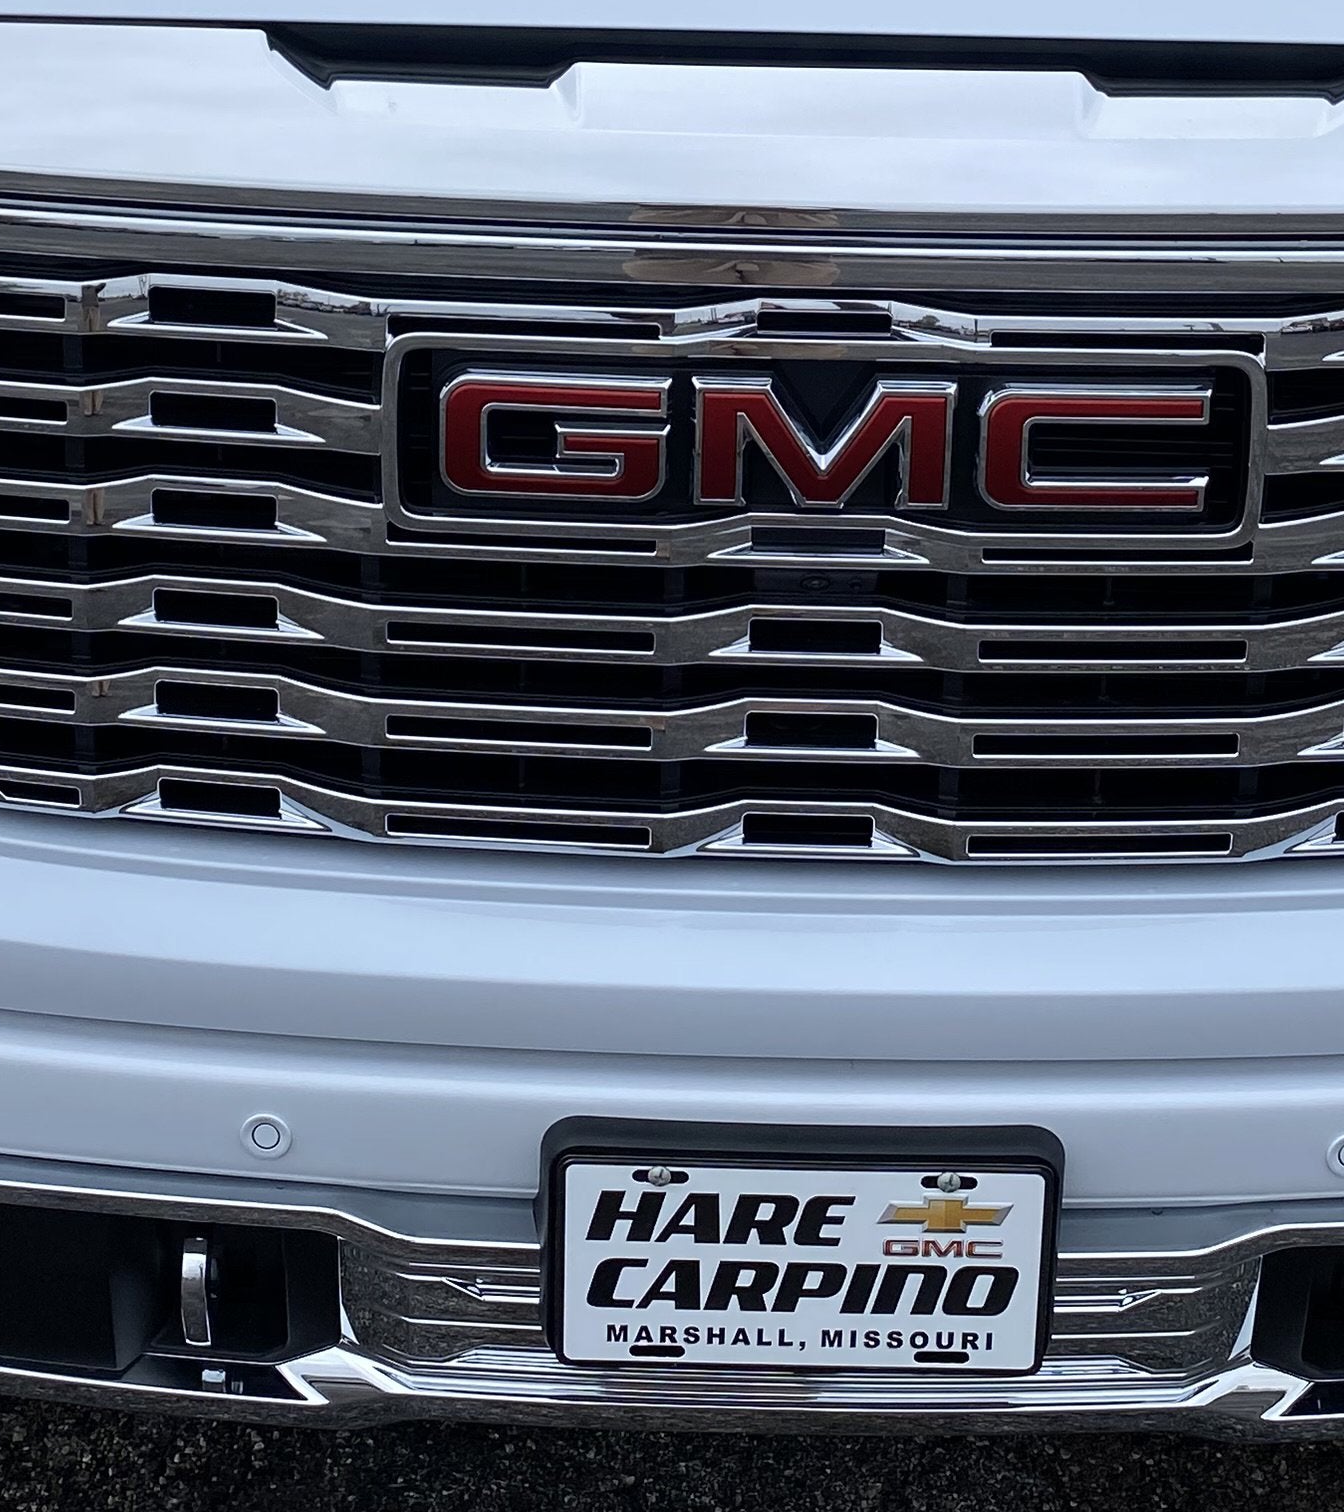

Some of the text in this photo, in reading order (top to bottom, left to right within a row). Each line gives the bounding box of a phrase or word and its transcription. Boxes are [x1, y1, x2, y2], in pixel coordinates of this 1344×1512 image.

[439, 371, 1213, 513] GMC
[585, 1189, 856, 1247] HARE
[882, 1238, 1004, 1260] GMC
[586, 1257, 1020, 1316] CARPINO
[606, 1324, 995, 1352] MARSHALL, MISSOURI
